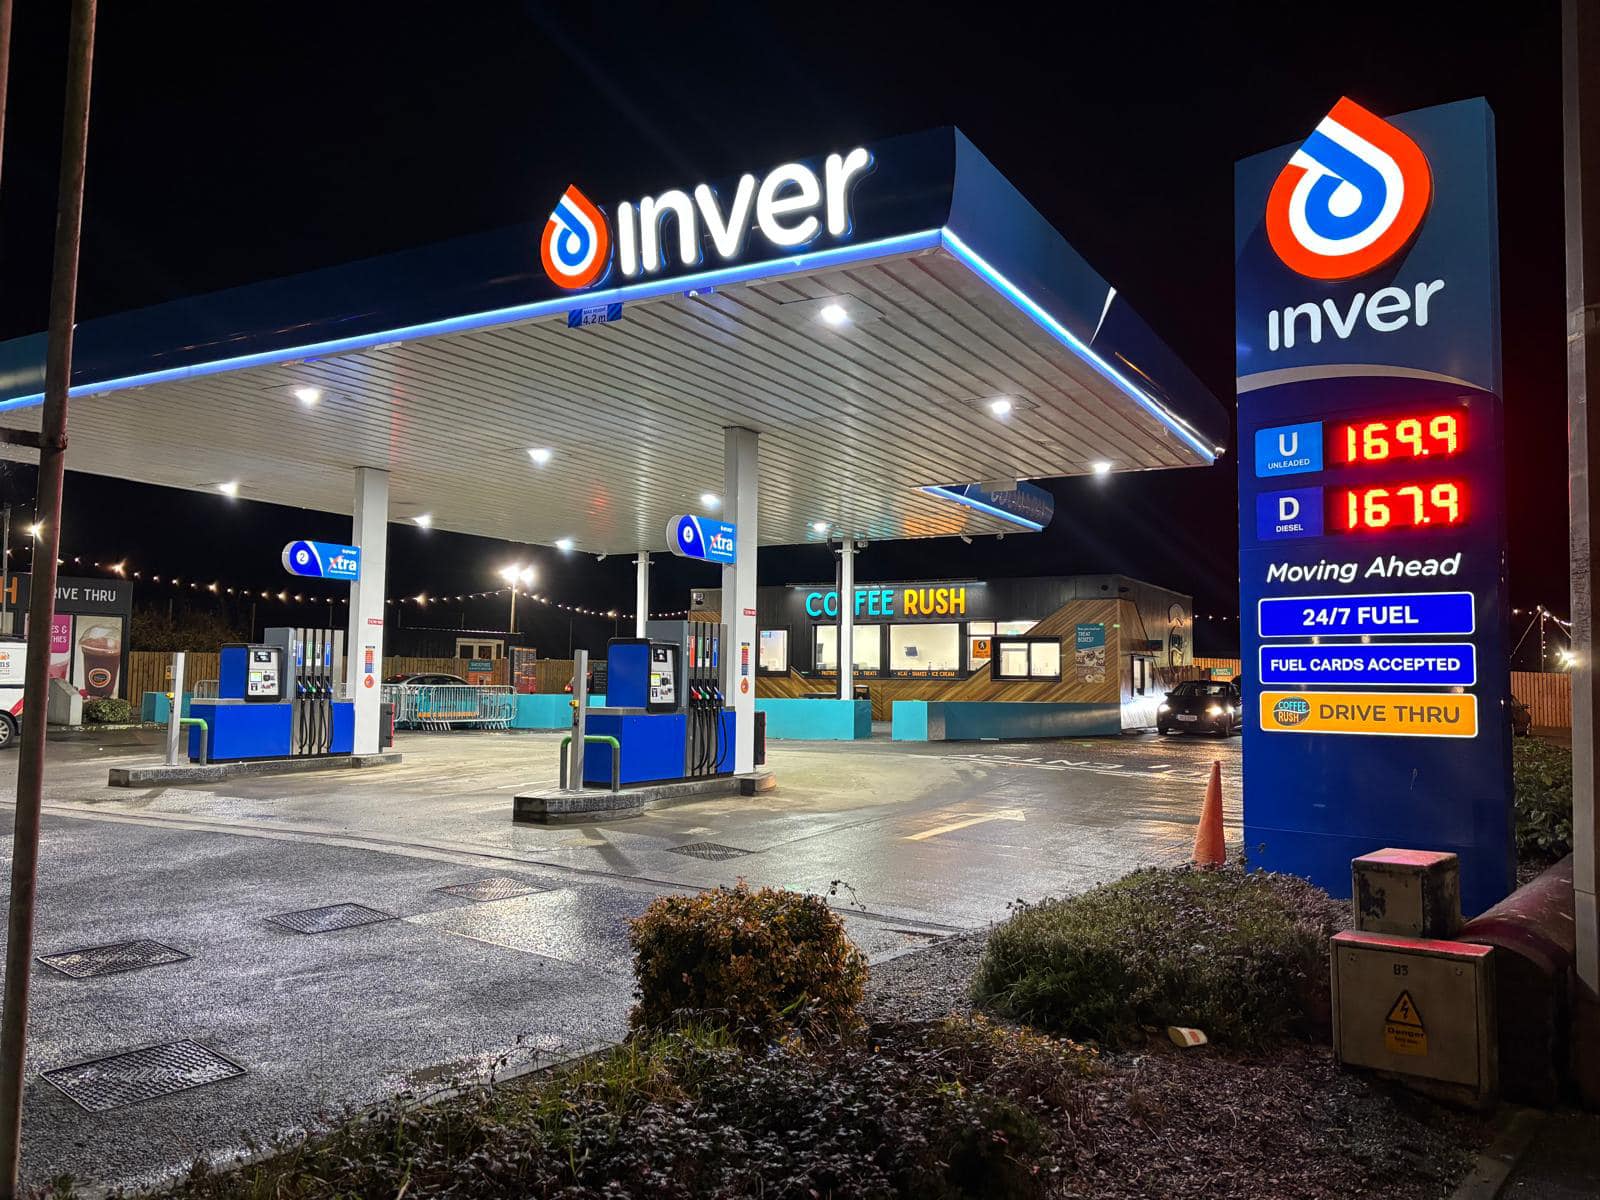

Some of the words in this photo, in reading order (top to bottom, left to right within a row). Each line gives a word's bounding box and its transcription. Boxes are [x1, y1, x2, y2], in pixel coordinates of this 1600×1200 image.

[617, 148, 868, 276] inver
[1268, 279, 1445, 351] inver
[1279, 432, 1298, 456] U
[1347, 415, 1457, 462] 169.9
[1268, 458, 1310, 470] UNLEADED
[1279, 497, 1300, 521] D
[1348, 483, 1458, 528] 167.9
[1275, 523, 1303, 533] DIESEL
[299, 552, 305, 561] 2
[1266, 559, 1358, 583] Moving
[1364, 552, 1462, 579] Ahead
[84, 588, 116, 602] THRU
[805, 589, 894, 617] COFEE
[903, 587, 966, 615] RUSH
[1302, 608, 1351, 626] 24/7
[1357, 605, 1419, 625] FUEL
[1270, 659, 1306, 672] FUEL
[1310, 658, 1364, 672] CARDS
[1367, 657, 1461, 671] ACCEPTED
[1278, 701, 1307, 712] COFFEE
[1278, 711, 1299, 723] RUSH
[1319, 704, 1386, 722] DRIVE
[1394, 705, 1460, 724] THRU
